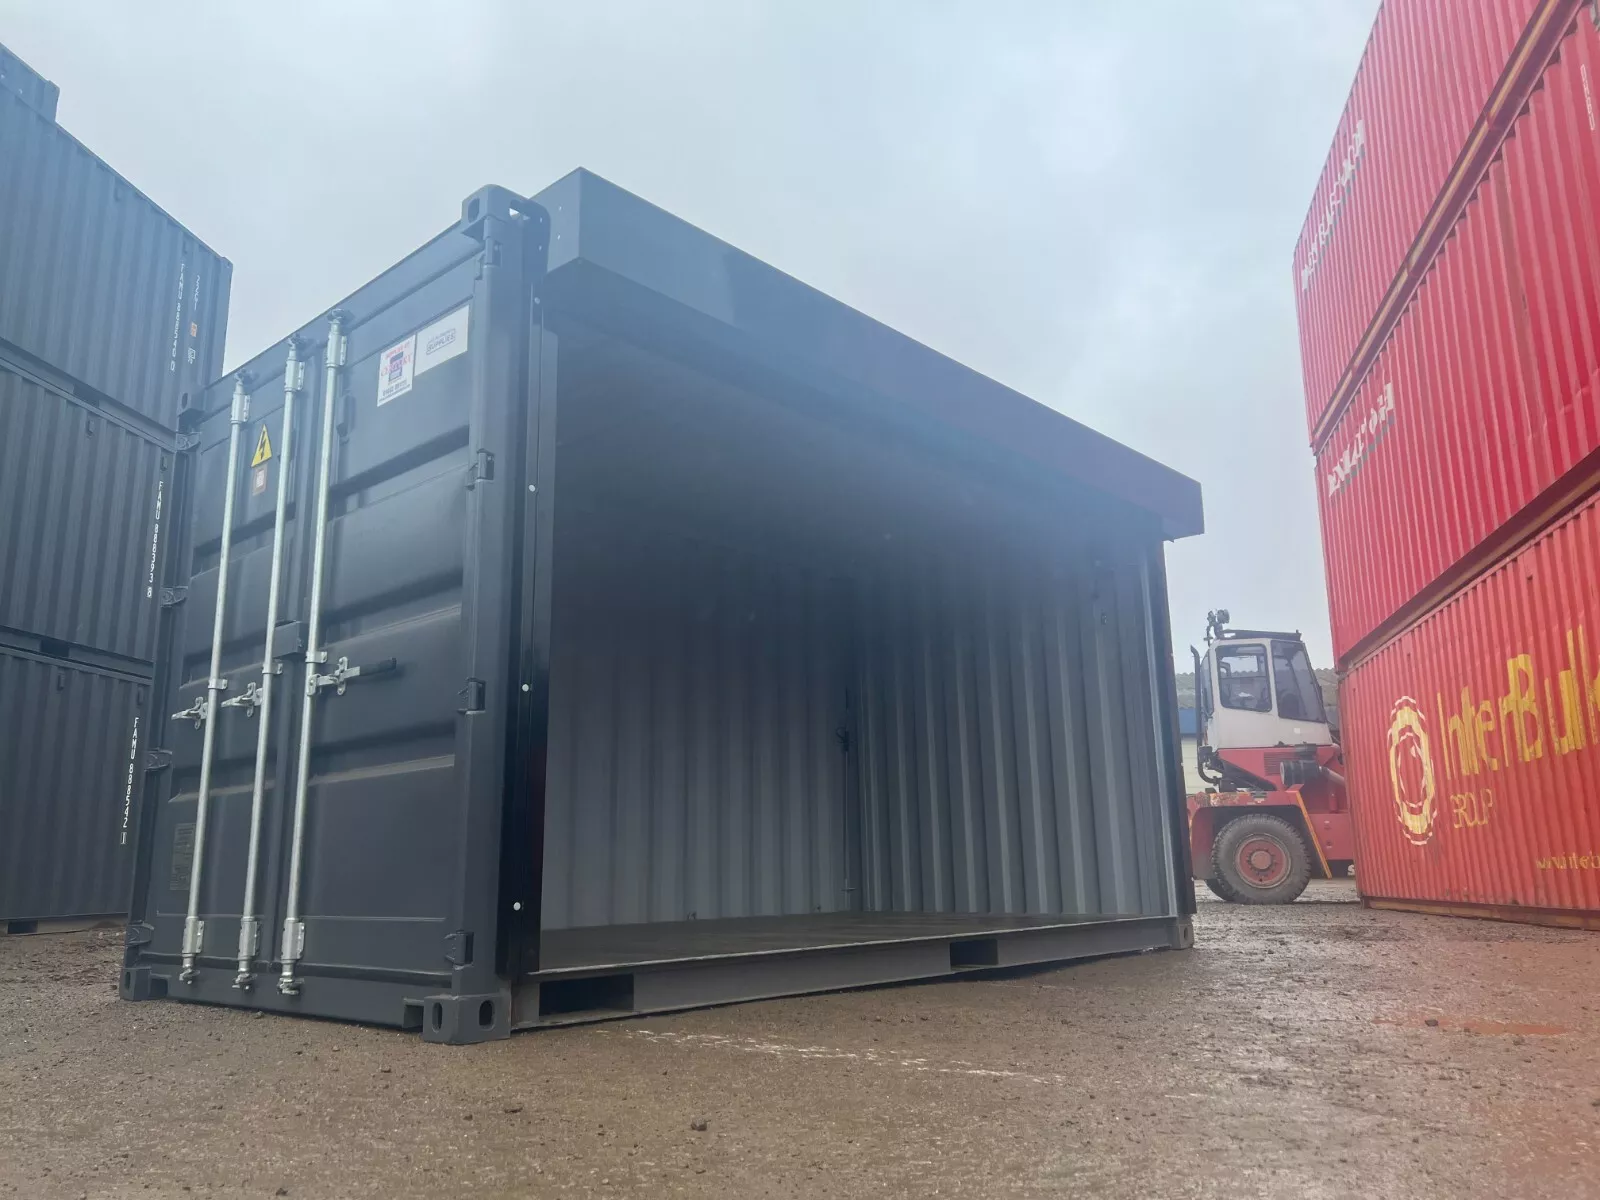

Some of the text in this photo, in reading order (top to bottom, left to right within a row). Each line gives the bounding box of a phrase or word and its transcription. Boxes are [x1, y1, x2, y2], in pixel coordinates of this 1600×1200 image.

[155, 481, 163, 520] FAMU
[149, 523, 159, 583] 888393
[130, 717, 139, 760] FAMU
[123, 763, 134, 828] 888542
